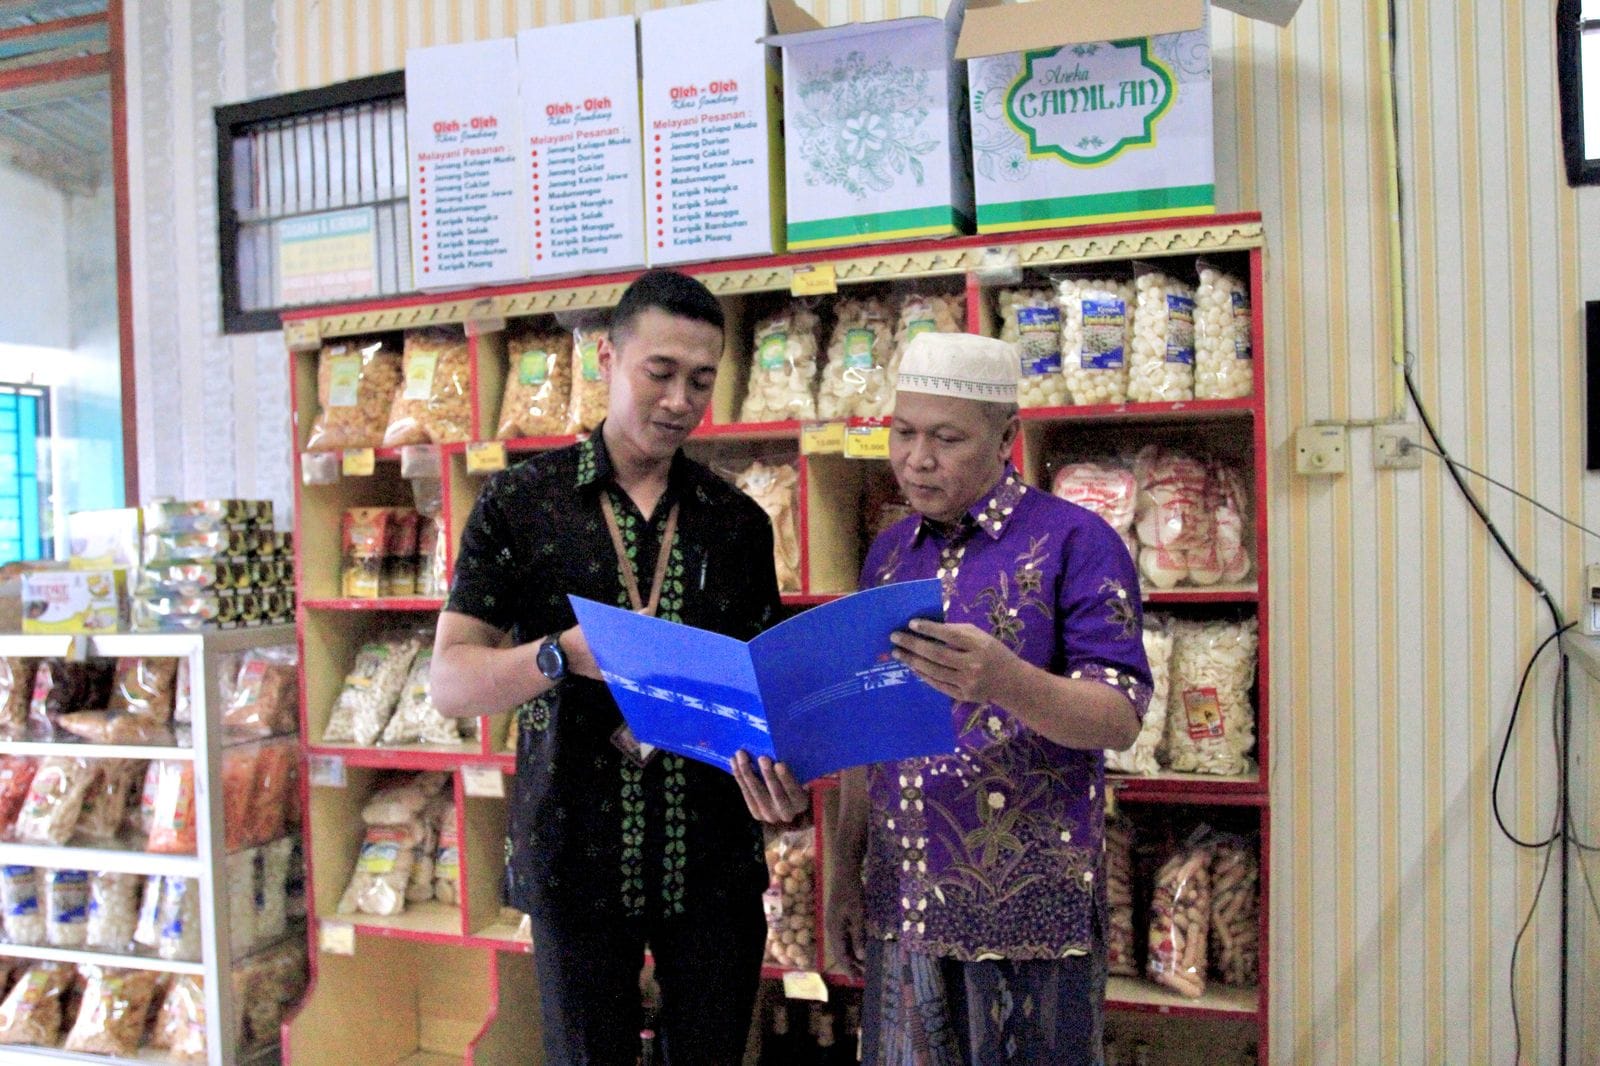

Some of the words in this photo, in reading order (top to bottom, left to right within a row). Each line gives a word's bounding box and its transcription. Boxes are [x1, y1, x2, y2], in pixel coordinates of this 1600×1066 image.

[1039, 62, 1089, 86] Aneka
[670, 87, 697, 99] Oleh
[709, 81, 737, 94] Oleh
[1019, 78, 1159, 119] CAMILAN
[653, 117, 698, 129] Melayani
[701, 111, 745, 123] Pesanan
